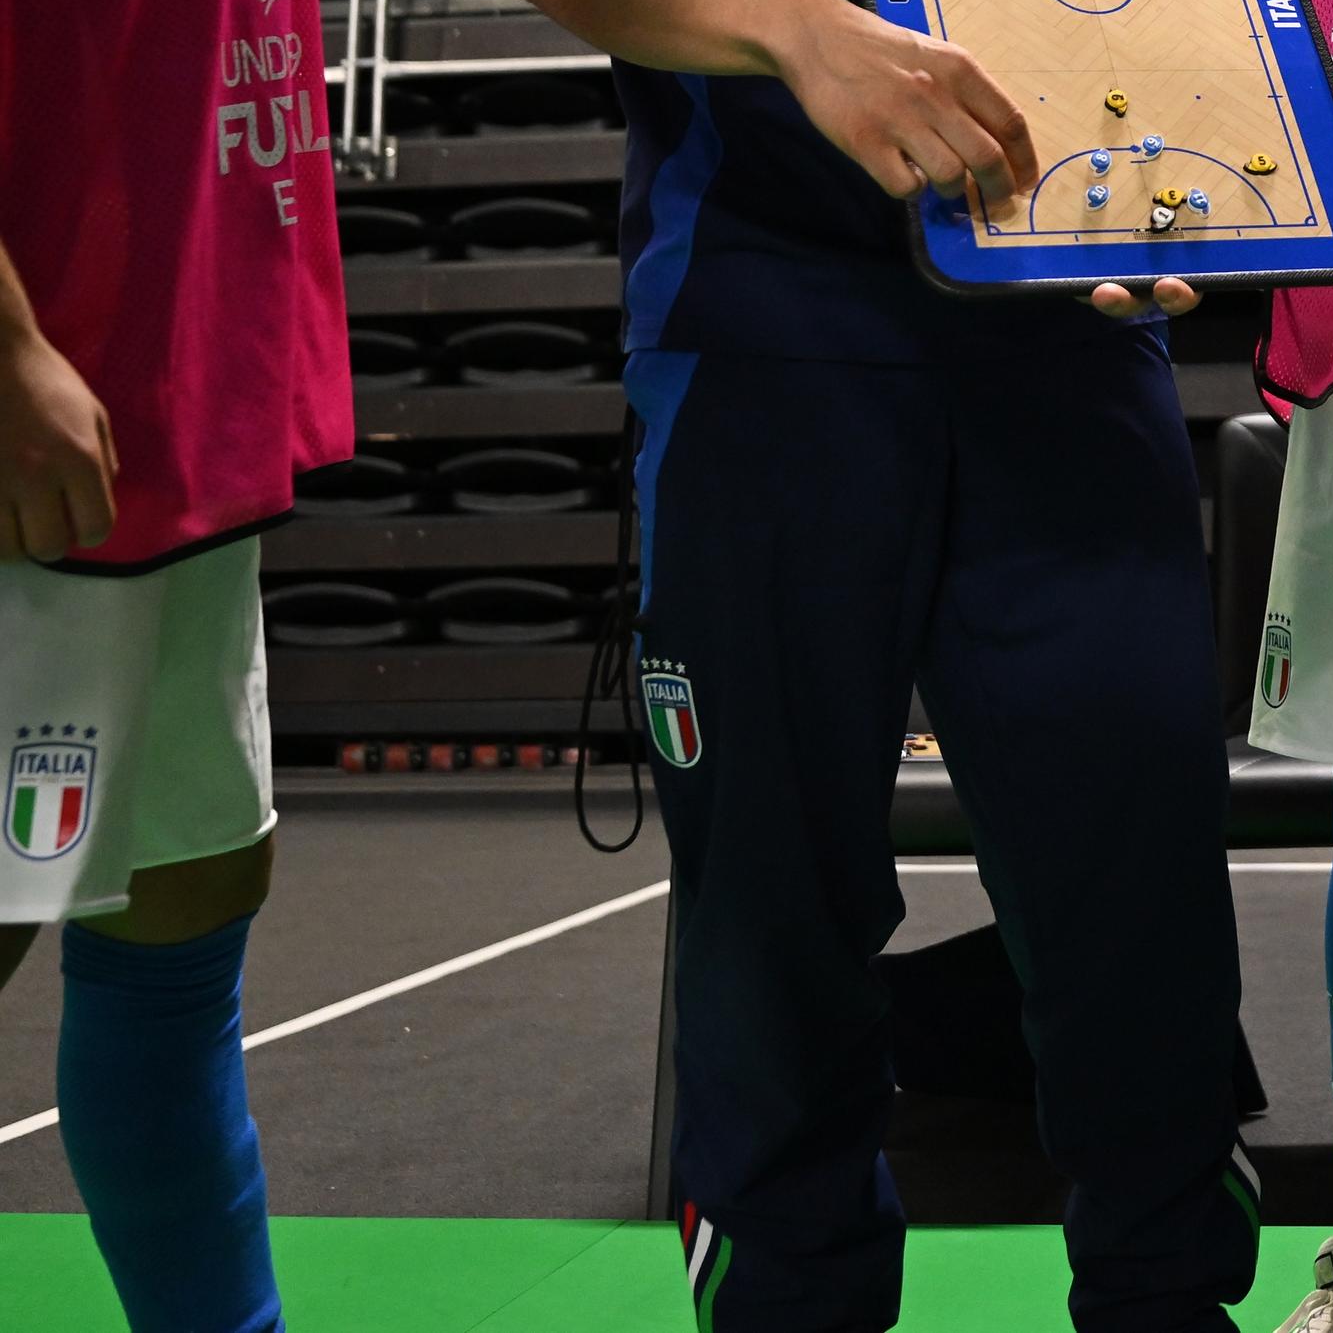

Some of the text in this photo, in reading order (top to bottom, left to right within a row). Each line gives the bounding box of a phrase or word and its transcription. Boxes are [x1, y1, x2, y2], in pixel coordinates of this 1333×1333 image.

[1096, 153, 1108, 162] 8
[1258, 155, 1266, 166] 5
[1094, 185, 1106, 199] 10
[1168, 190, 1177, 201] 3
[1268, 631, 1290, 651] ITALIA
[646, 683, 687, 702] ITALIA
[18, 753, 86, 774] ITALIA
